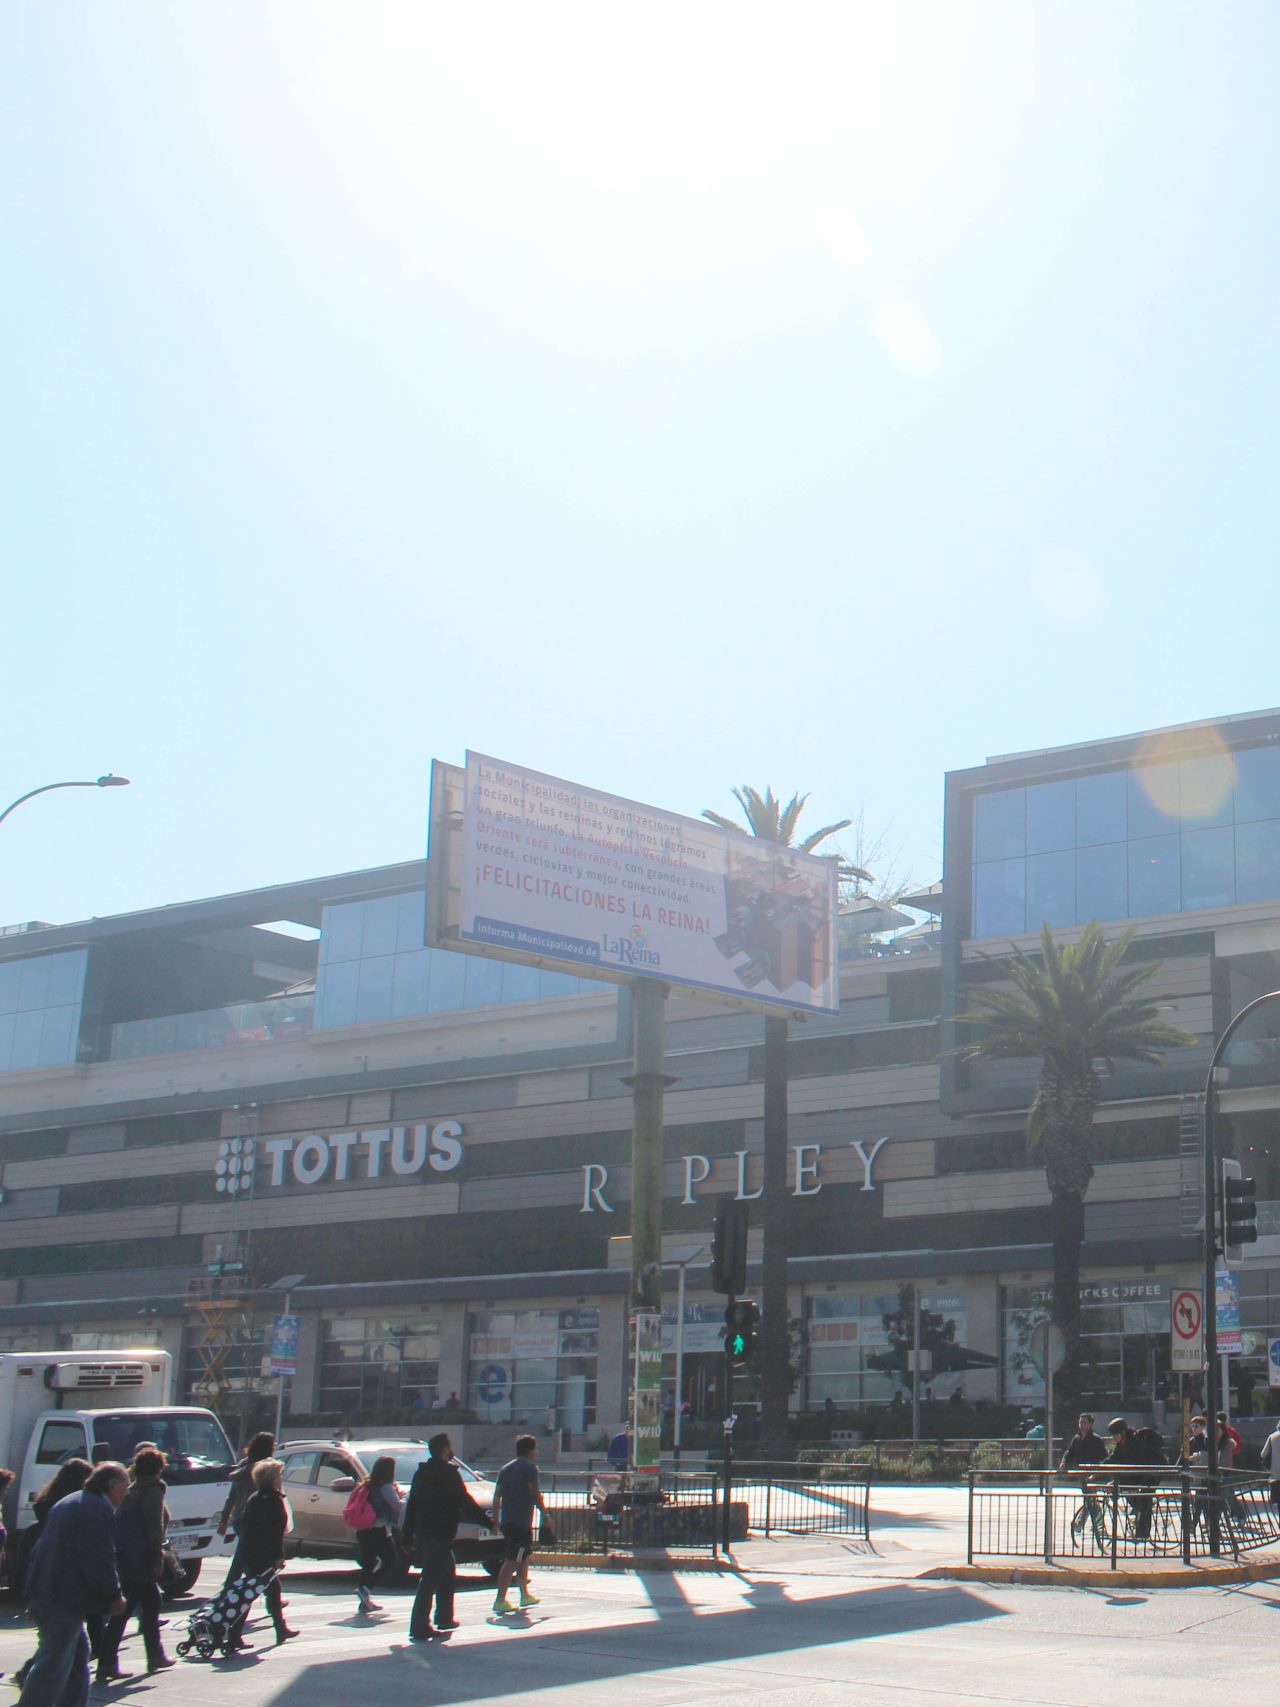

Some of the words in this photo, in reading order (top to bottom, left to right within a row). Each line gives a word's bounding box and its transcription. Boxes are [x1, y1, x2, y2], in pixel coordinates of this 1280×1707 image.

[479, 766, 491, 780] La
[584, 799, 598, 812] las
[602, 805, 681, 836] organizaciones
[479, 786, 524, 808] sociales
[529, 801, 536, 813] y
[540, 802, 556, 817] las
[560, 810, 602, 830] reininas
[606, 824, 613, 834] y
[616, 825, 657, 846] reininos
[660, 838, 706, 860] logramos
[477, 805, 491, 816] un
[496, 809, 521, 825] gran
[572, 829, 584, 841] La
[588, 833, 640, 857] Autopista
[643, 847, 688, 870] Vespucio
[477, 821, 521, 843] Oriente
[527, 837, 549, 850] será
[625, 862, 643, 875] con
[647, 868, 687, 887] grandes
[475, 863, 626, 914] ¡FELICITACIONES
[632, 901, 652, 921] LA
[658, 907, 711, 935] REINA!
[577, 868, 583, 879] y
[587, 869, 618, 887] mejor
[477, 922, 515, 940] Informa
[518, 930, 584, 956] Municipalidad
[585, 945, 597, 958] de
[265, 1120, 464, 1187] TOTTUS
[579, 1136, 892, 1213] RPLEY
[1111, 1284, 1161, 1298] COFFEE
